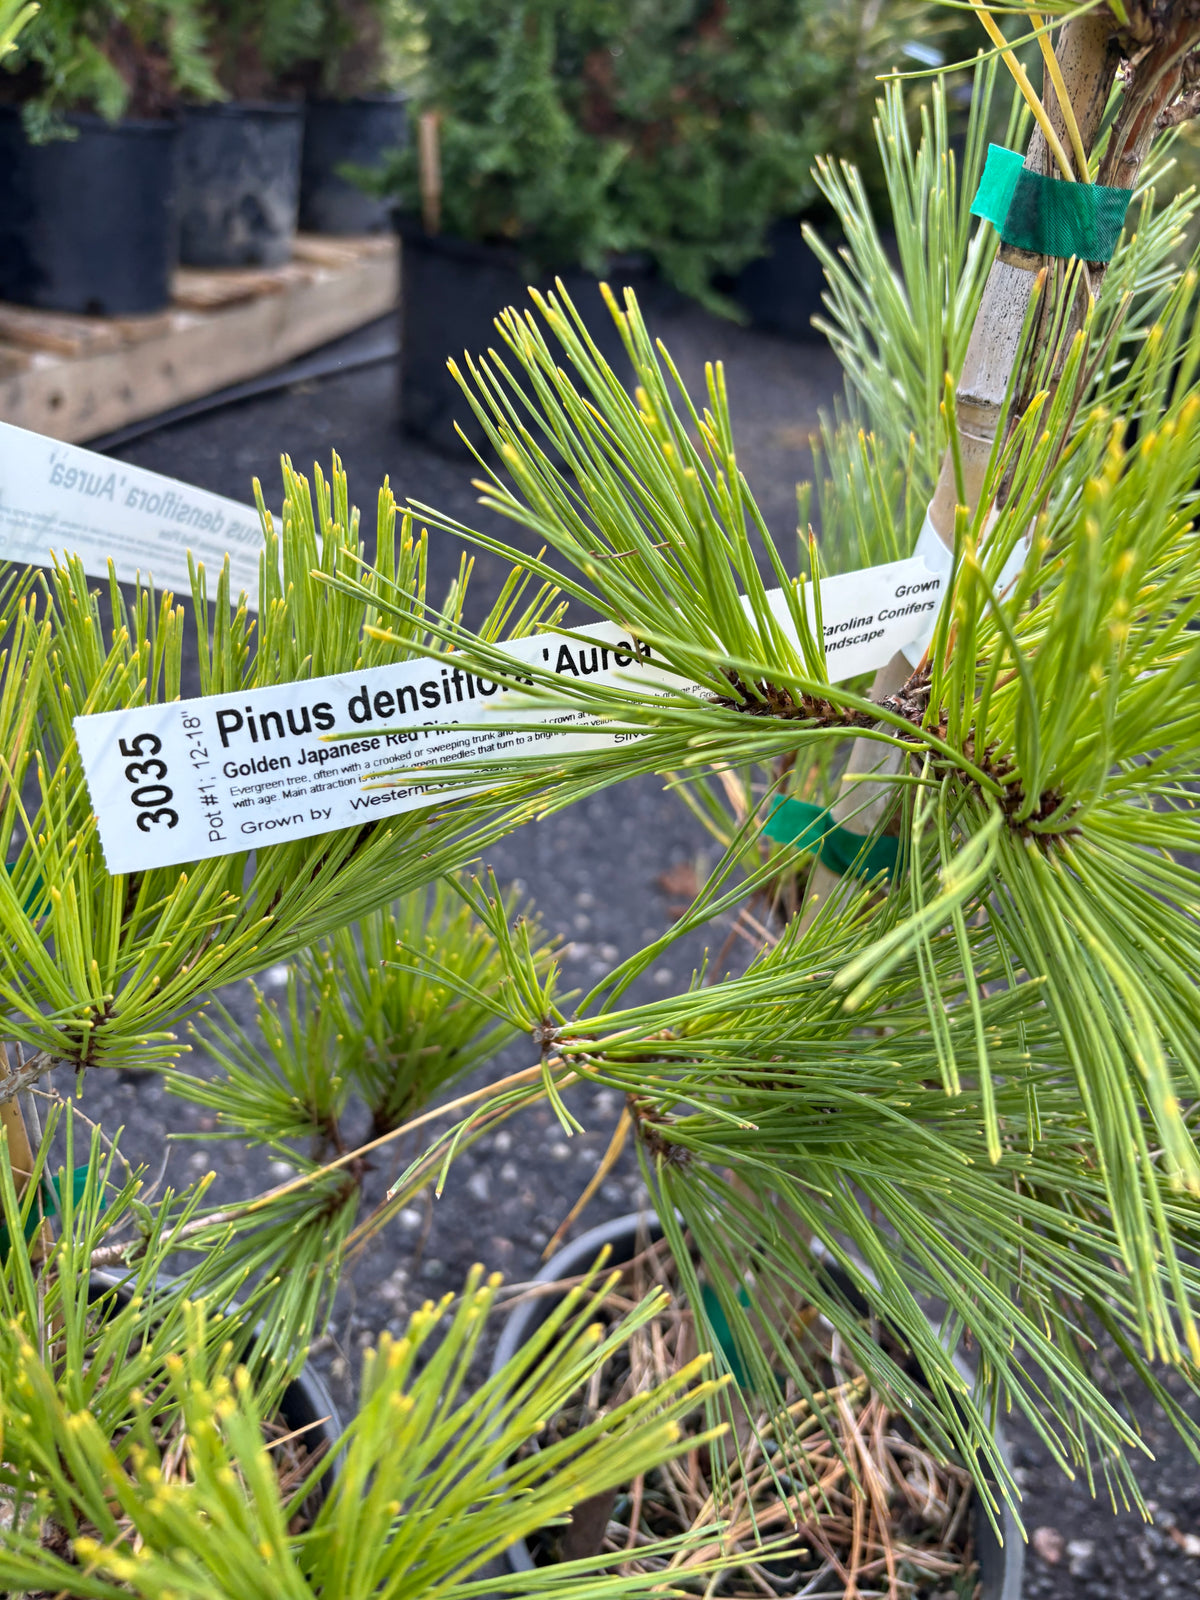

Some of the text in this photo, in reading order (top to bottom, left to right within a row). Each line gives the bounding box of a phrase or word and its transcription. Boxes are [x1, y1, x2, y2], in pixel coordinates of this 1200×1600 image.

[877, 600, 935, 623] Conifers
[894, 578, 940, 599] Grown
[824, 628, 885, 653] ndscape
[180, 710, 210, 770] 12-18"
[215, 702, 336, 748] Pinus
[222, 755, 292, 779] Golden
[297, 736, 381, 766] Japanese
[385, 725, 418, 747] Red
[229, 779, 285, 797] Evergreen
[286, 773, 312, 786] tree,
[313, 767, 339, 780] often
[341, 761, 362, 774] with
[364, 761, 371, 770] a
[373, 750, 412, 767] crooked
[414, 747, 424, 758] or
[426, 737, 471, 756] sweeping
[472, 730, 496, 744] trunk
[548, 715, 576, 725] crown
[232, 796, 255, 809] with
[282, 786, 308, 800] Main
[310, 776, 357, 794] attraction
[439, 748, 476, 764] needles
[477, 743, 495, 754] that
[496, 739, 515, 750] turn
[516, 736, 525, 746] to
[526, 735, 533, 743] a
[534, 731, 560, 741] brig
[118, 732, 179, 833] 3035
[203, 810, 227, 843] Pot
[240, 812, 304, 835] Grown
[309, 807, 332, 821] by
